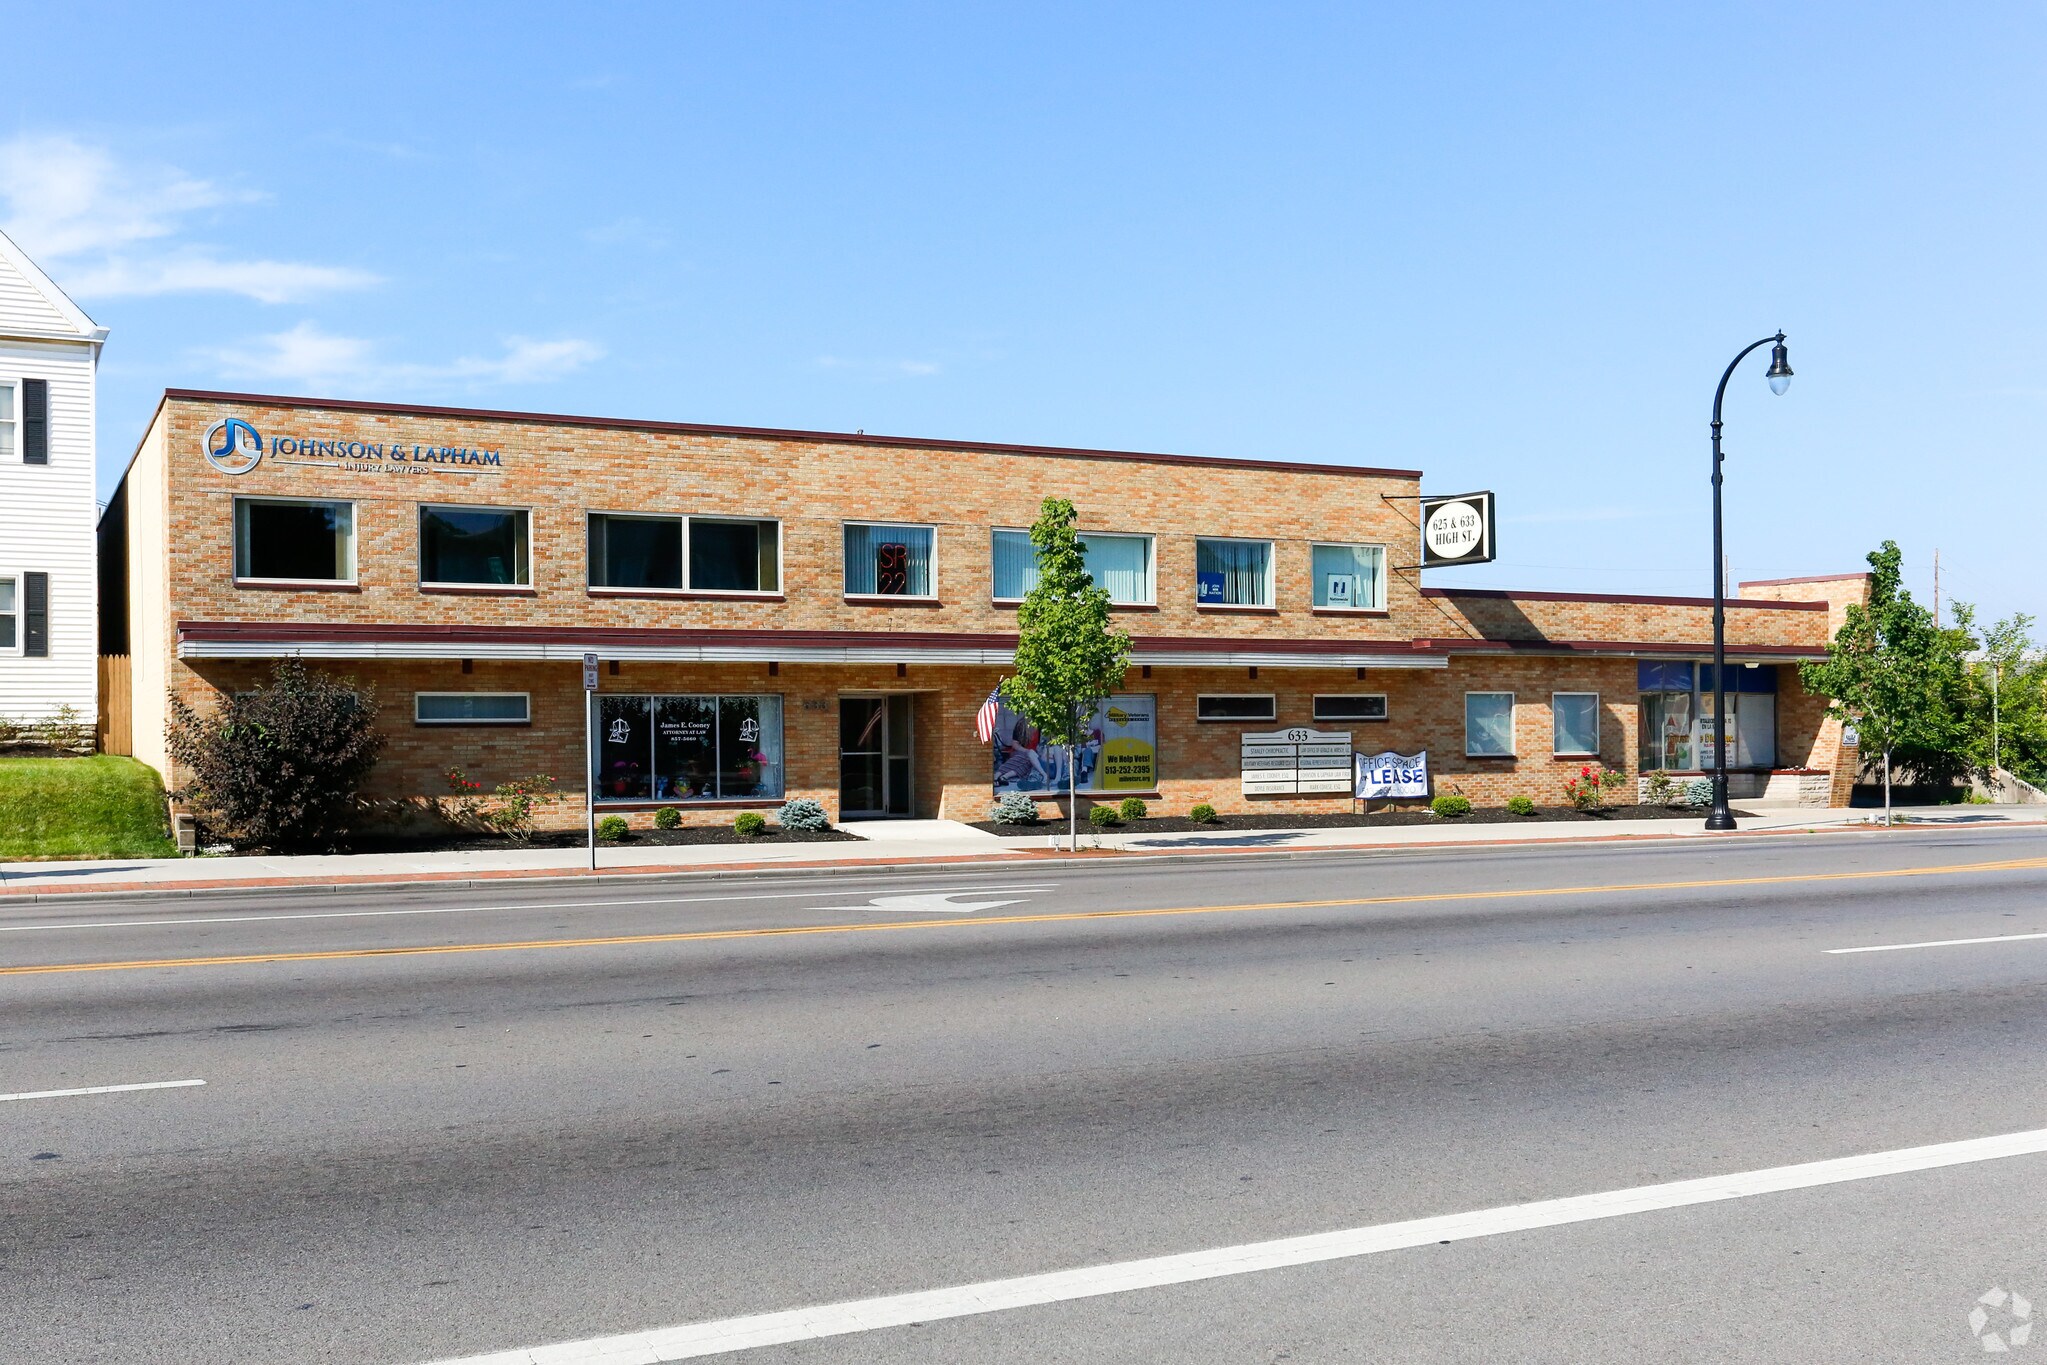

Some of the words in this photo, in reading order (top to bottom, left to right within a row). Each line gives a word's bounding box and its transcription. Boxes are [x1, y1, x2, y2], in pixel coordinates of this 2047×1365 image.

[270, 437, 383, 459] JOHNSON
[390, 443, 408, 461] &
[412, 444, 502, 466] LAPHAM
[344, 461, 382, 473] INJURY
[384, 464, 429, 475] LAWYERS
[1432, 518, 1448, 531] 625
[1450, 517, 1457, 529] &
[1460, 514, 1475, 528] 633
[1435, 531, 1459, 546] HIGH
[1461, 529, 1476, 543] ST.
[880, 543, 907, 569] SR
[880, 572, 906, 595] 22
[660, 721, 680, 729] James
[680, 721, 688, 729] E.
[688, 721, 711, 730] Cooney
[1287, 729, 1309, 742] 633
[1250, 747, 1265, 755] STANLEY
[1107, 755, 1118, 763] We
[1119, 755, 1133, 763] Help
[1134, 755, 1150, 763] Vets!
[1359, 756, 1391, 769] OFFICE
[1391, 756, 1422, 769] SPACE
[1105, 765, 1150, 774] 513-252-2395
[1370, 769, 1424, 785] LEASE
